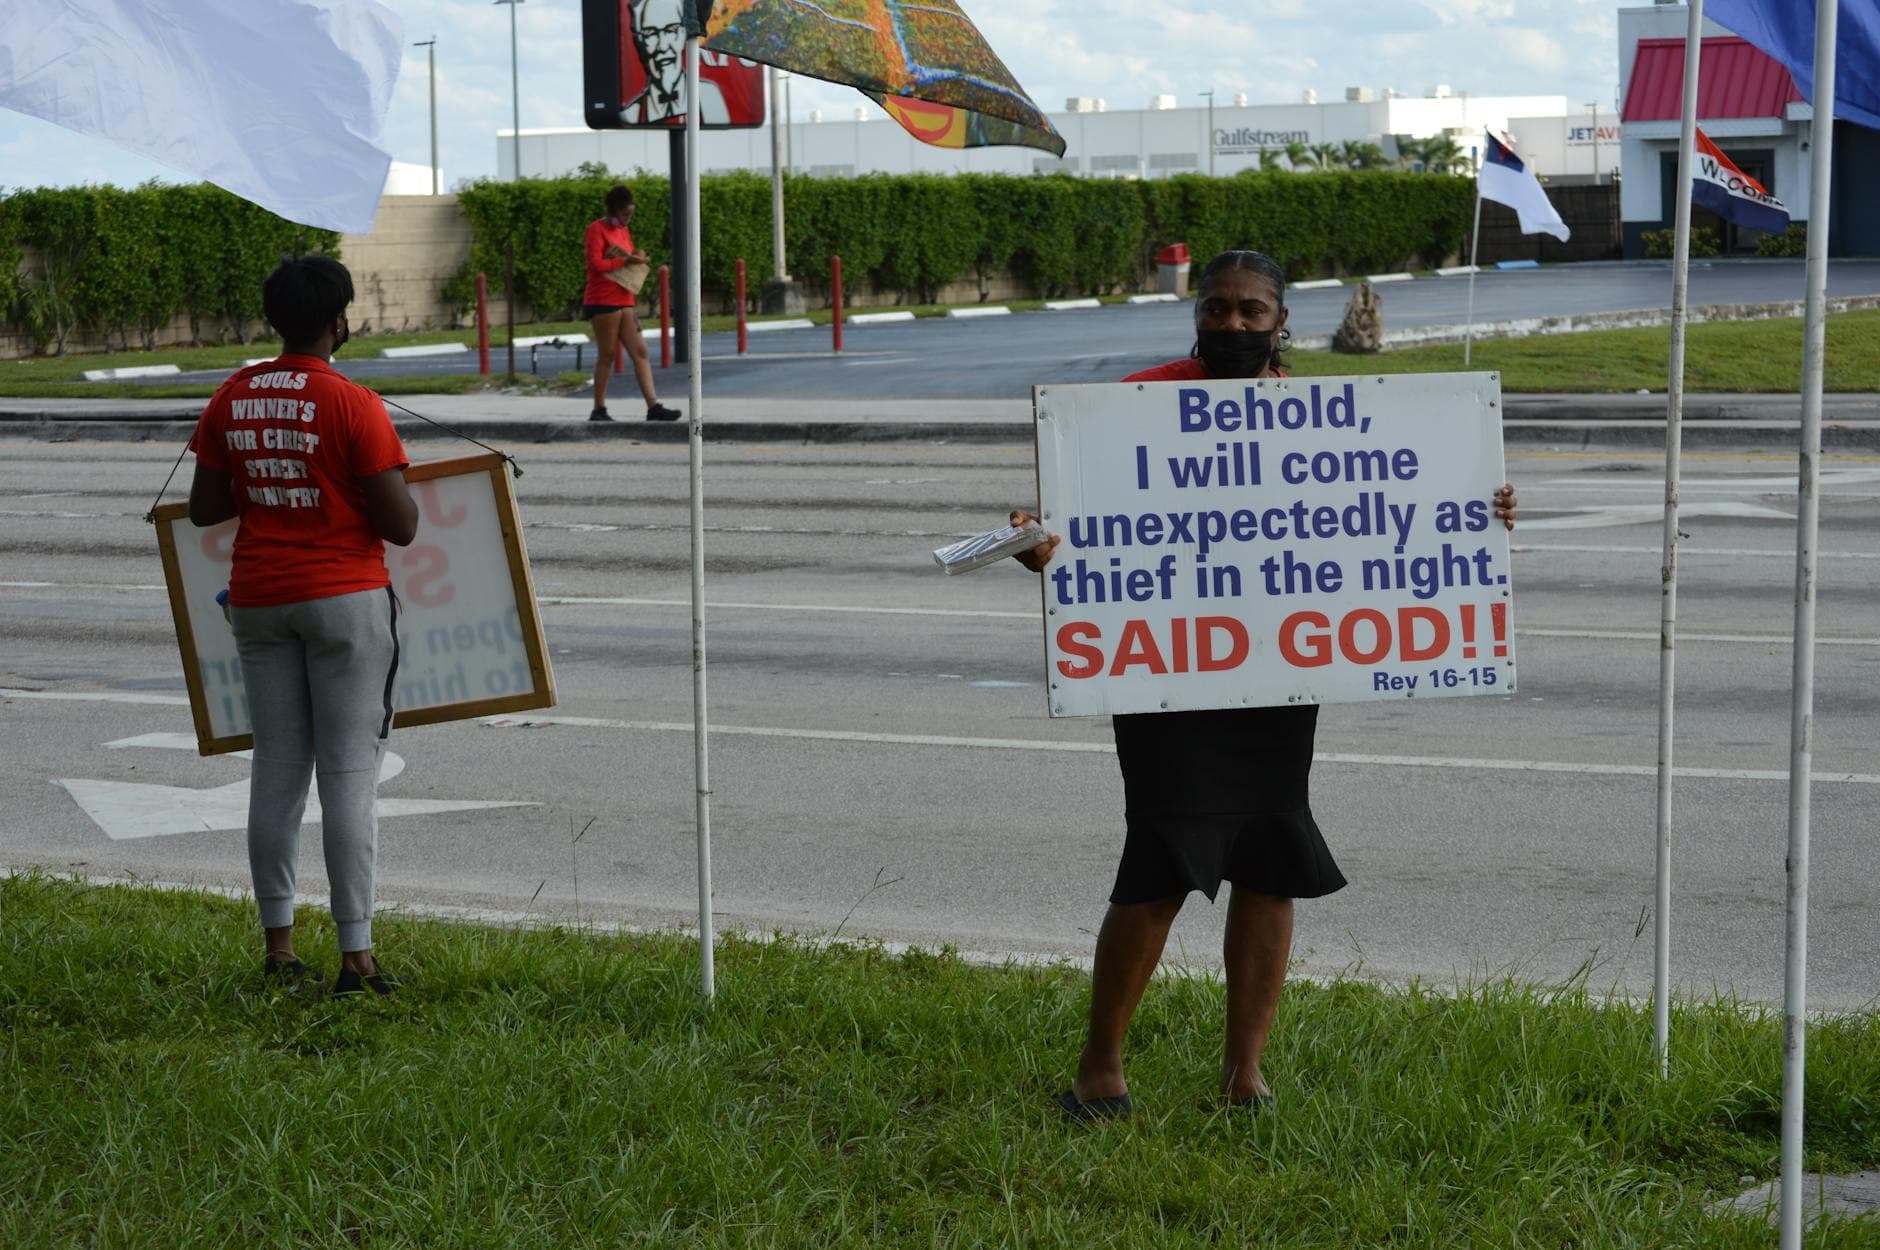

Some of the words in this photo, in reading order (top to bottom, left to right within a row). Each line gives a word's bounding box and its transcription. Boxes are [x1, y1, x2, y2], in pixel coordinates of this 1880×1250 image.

[1215, 128, 1309, 146] Gulfstream
[1567, 127, 1595, 140] JET
[248, 371, 308, 390] SOULS
[231, 398, 317, 423] WINNER'S
[1179, 384, 1372, 434] Behold,
[225, 429, 258, 451] FOR
[1136, 445, 1150, 490] I
[1167, 441, 1262, 489] will
[1281, 448, 1419, 485] come
[246, 485, 321, 509] MINITRY
[1068, 491, 1417, 555] unexpectedly
[1435, 500, 1489, 534] as
[1050, 555, 1177, 606] thief
[1196, 554, 1242, 599] in
[1259, 550, 1344, 596] the
[1361, 543, 1507, 600] night.
[1056, 615, 1250, 679] SAID
[1278, 602, 1508, 669] GOD!!
[1373, 669, 1419, 692] Rev
[1428, 666, 1497, 689] 16-15
